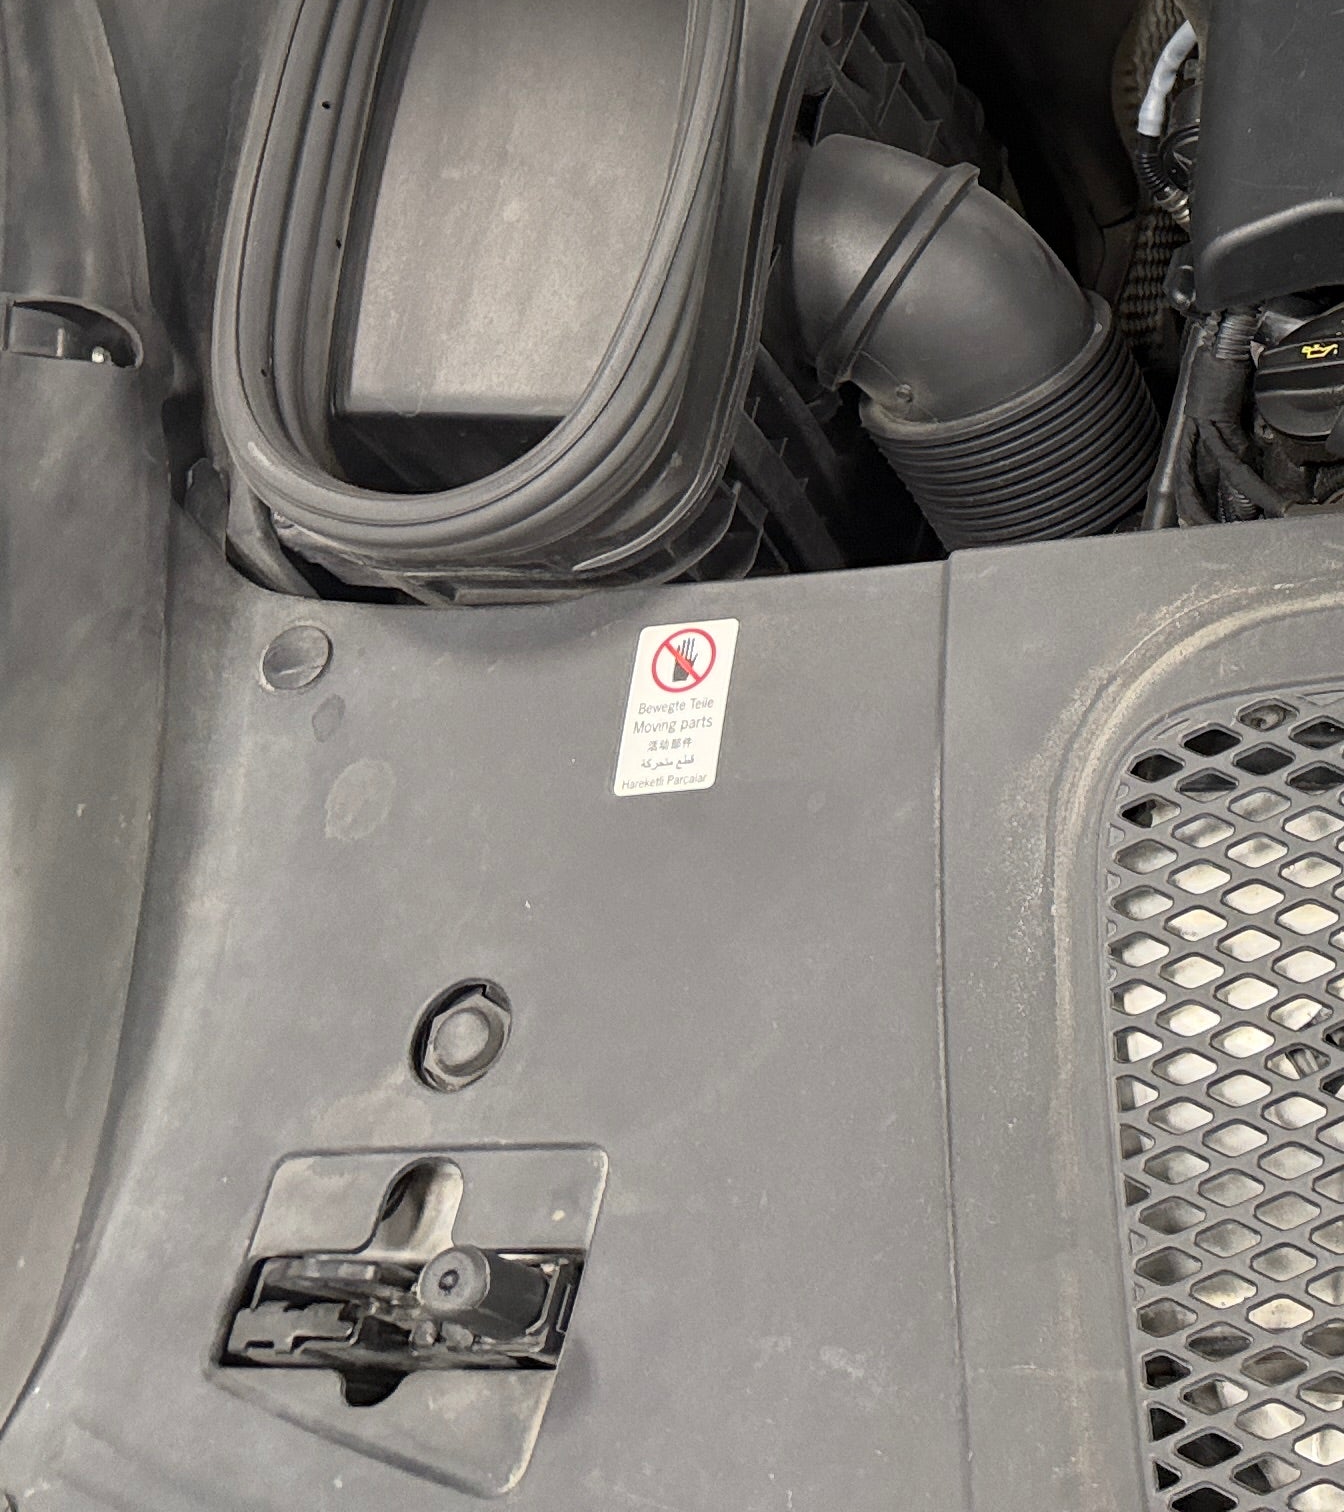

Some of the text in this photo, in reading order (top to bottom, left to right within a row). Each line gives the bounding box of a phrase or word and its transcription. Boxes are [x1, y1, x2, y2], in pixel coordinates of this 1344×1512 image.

[638, 696, 714, 715] Bewegte Teile
[633, 716, 713, 734] Moving parts
